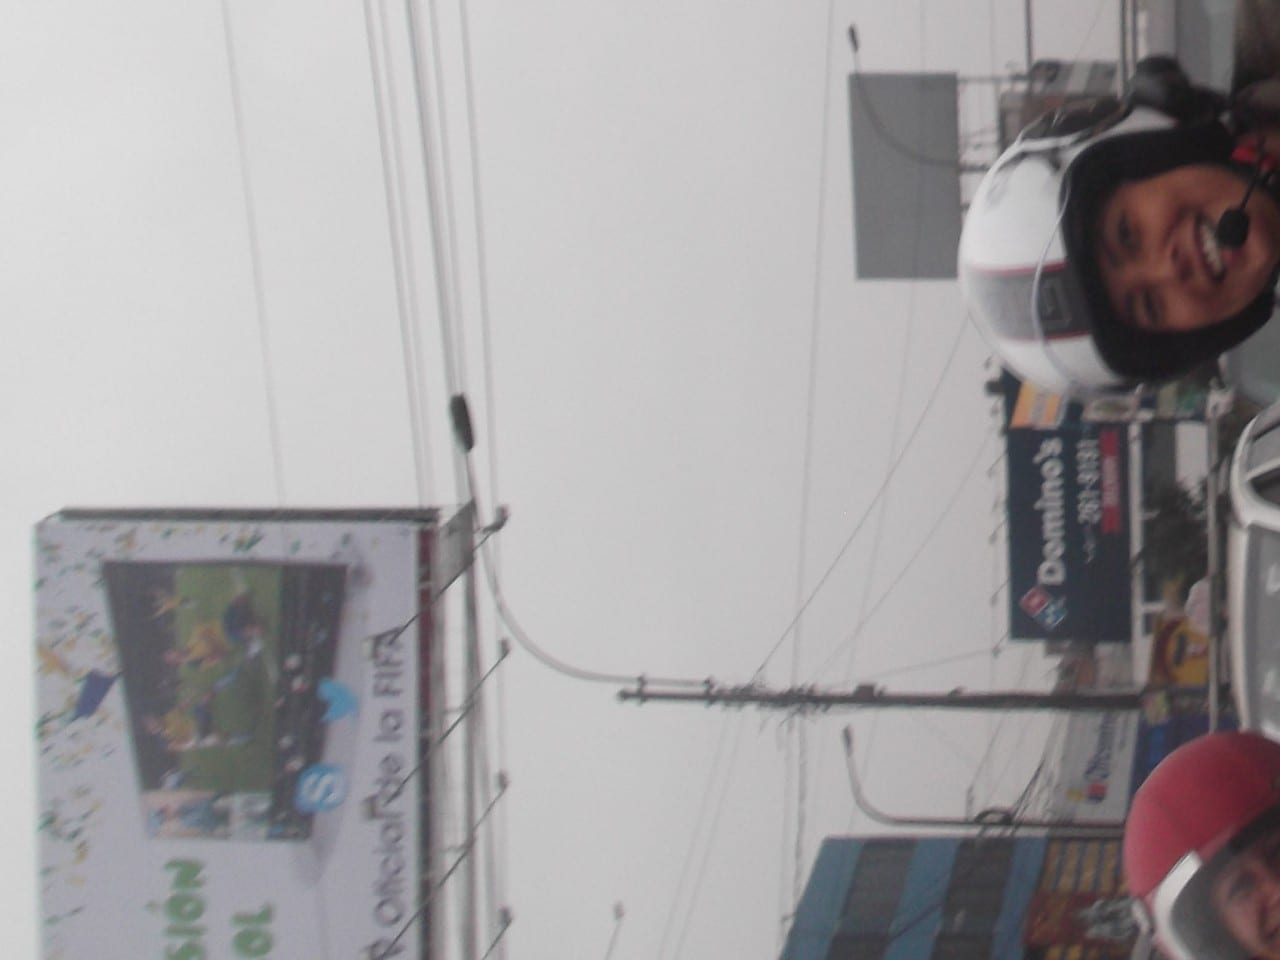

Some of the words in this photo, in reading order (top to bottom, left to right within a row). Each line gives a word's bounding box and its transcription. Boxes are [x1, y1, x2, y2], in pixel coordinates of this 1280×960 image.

[1033, 436, 1066, 586] Domino's
[372, 627, 404, 697] FIFA
[372, 708, 404, 743] la
[373, 753, 404, 801] de
[371, 811, 404, 928] Oficial
